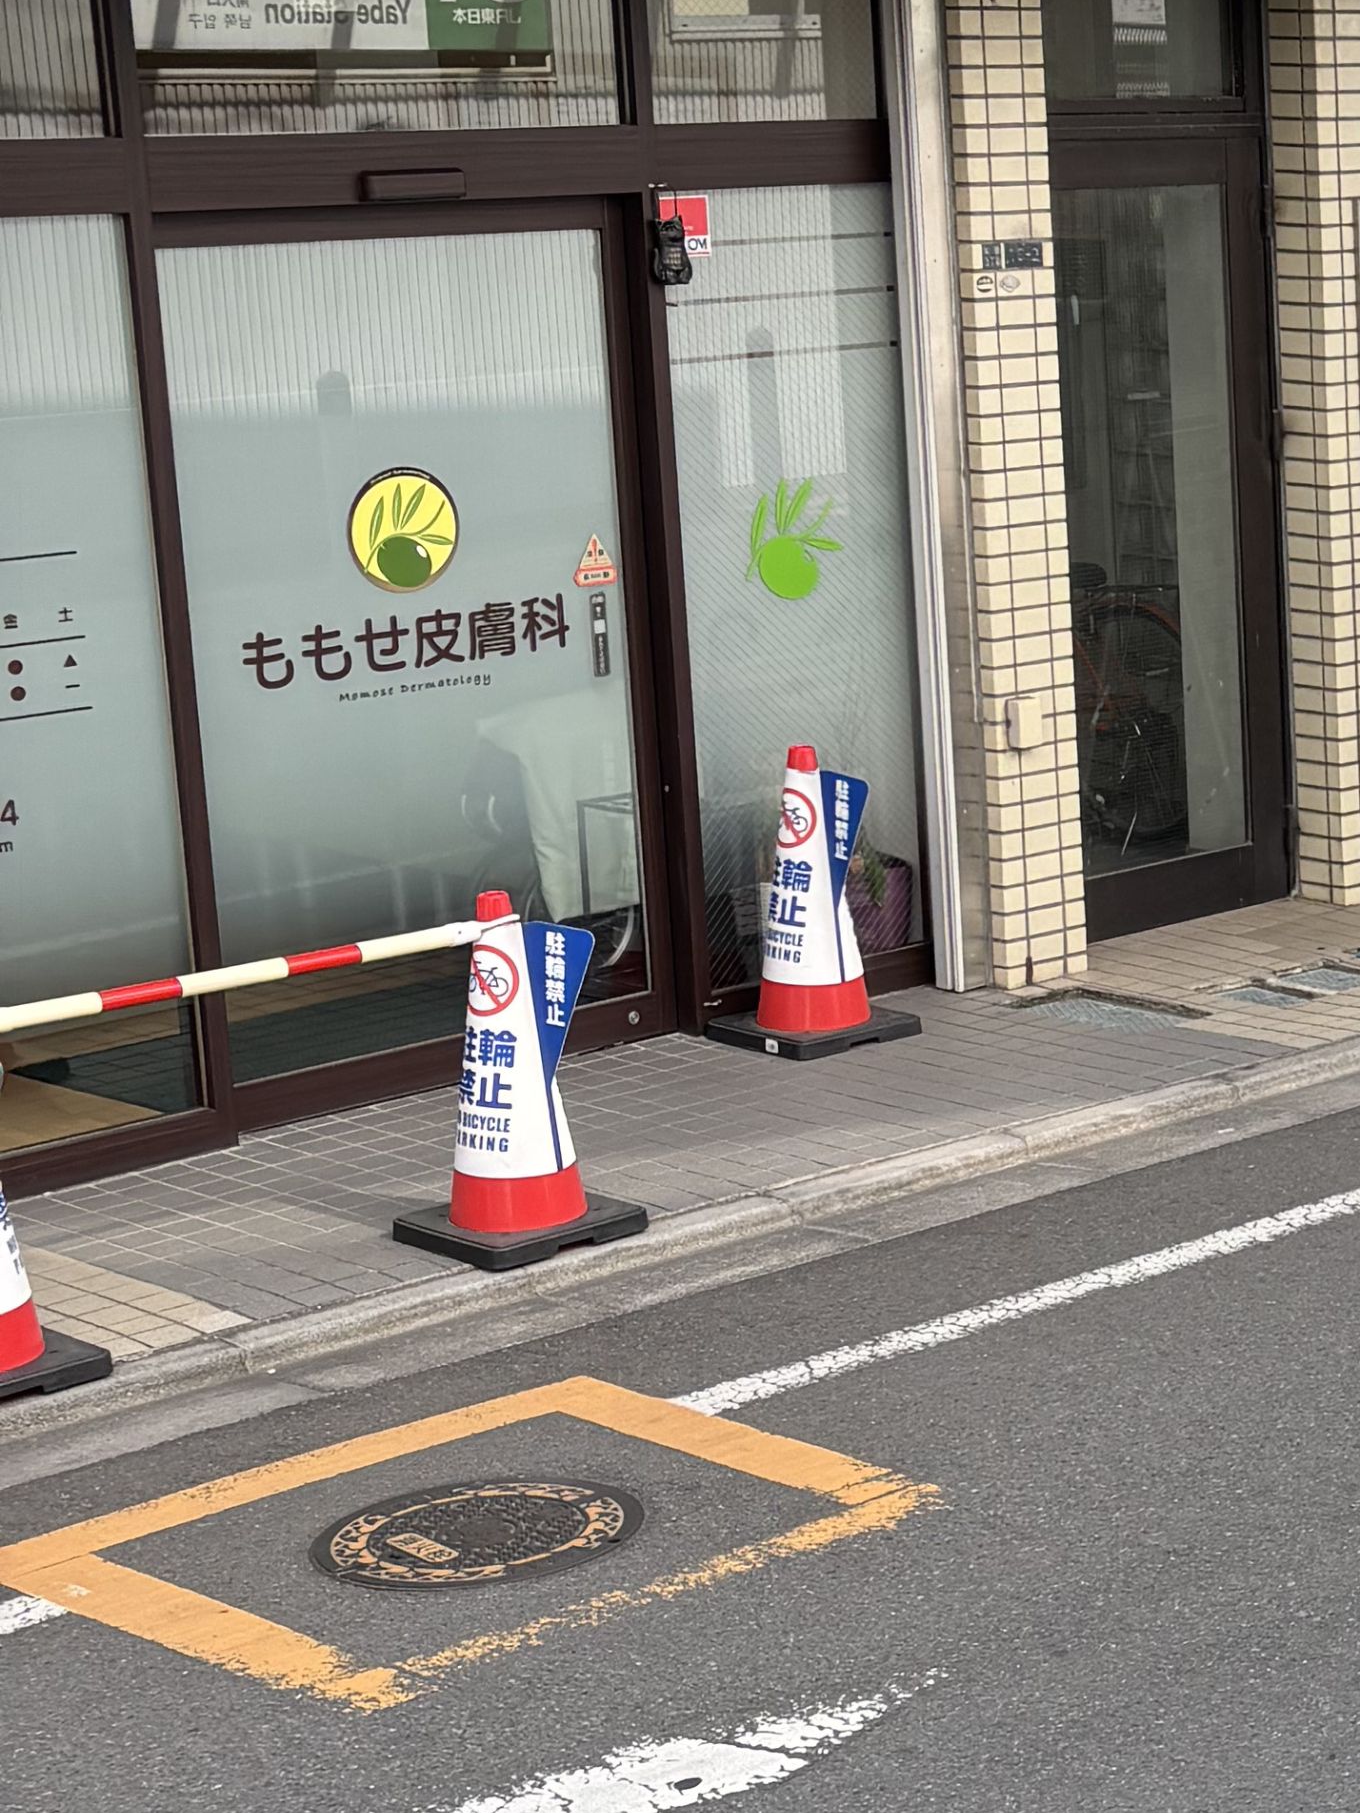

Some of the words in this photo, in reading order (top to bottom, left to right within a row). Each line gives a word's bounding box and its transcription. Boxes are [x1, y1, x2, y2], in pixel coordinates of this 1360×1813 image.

[58, 607, 74, 623] 土
[242, 593, 570, 691] ももせ皮膚科
[338, 686, 395, 703] Momose
[400, 672, 492, 694] Dermatology
[545, 931, 567, 1027] 駐輪禁止
